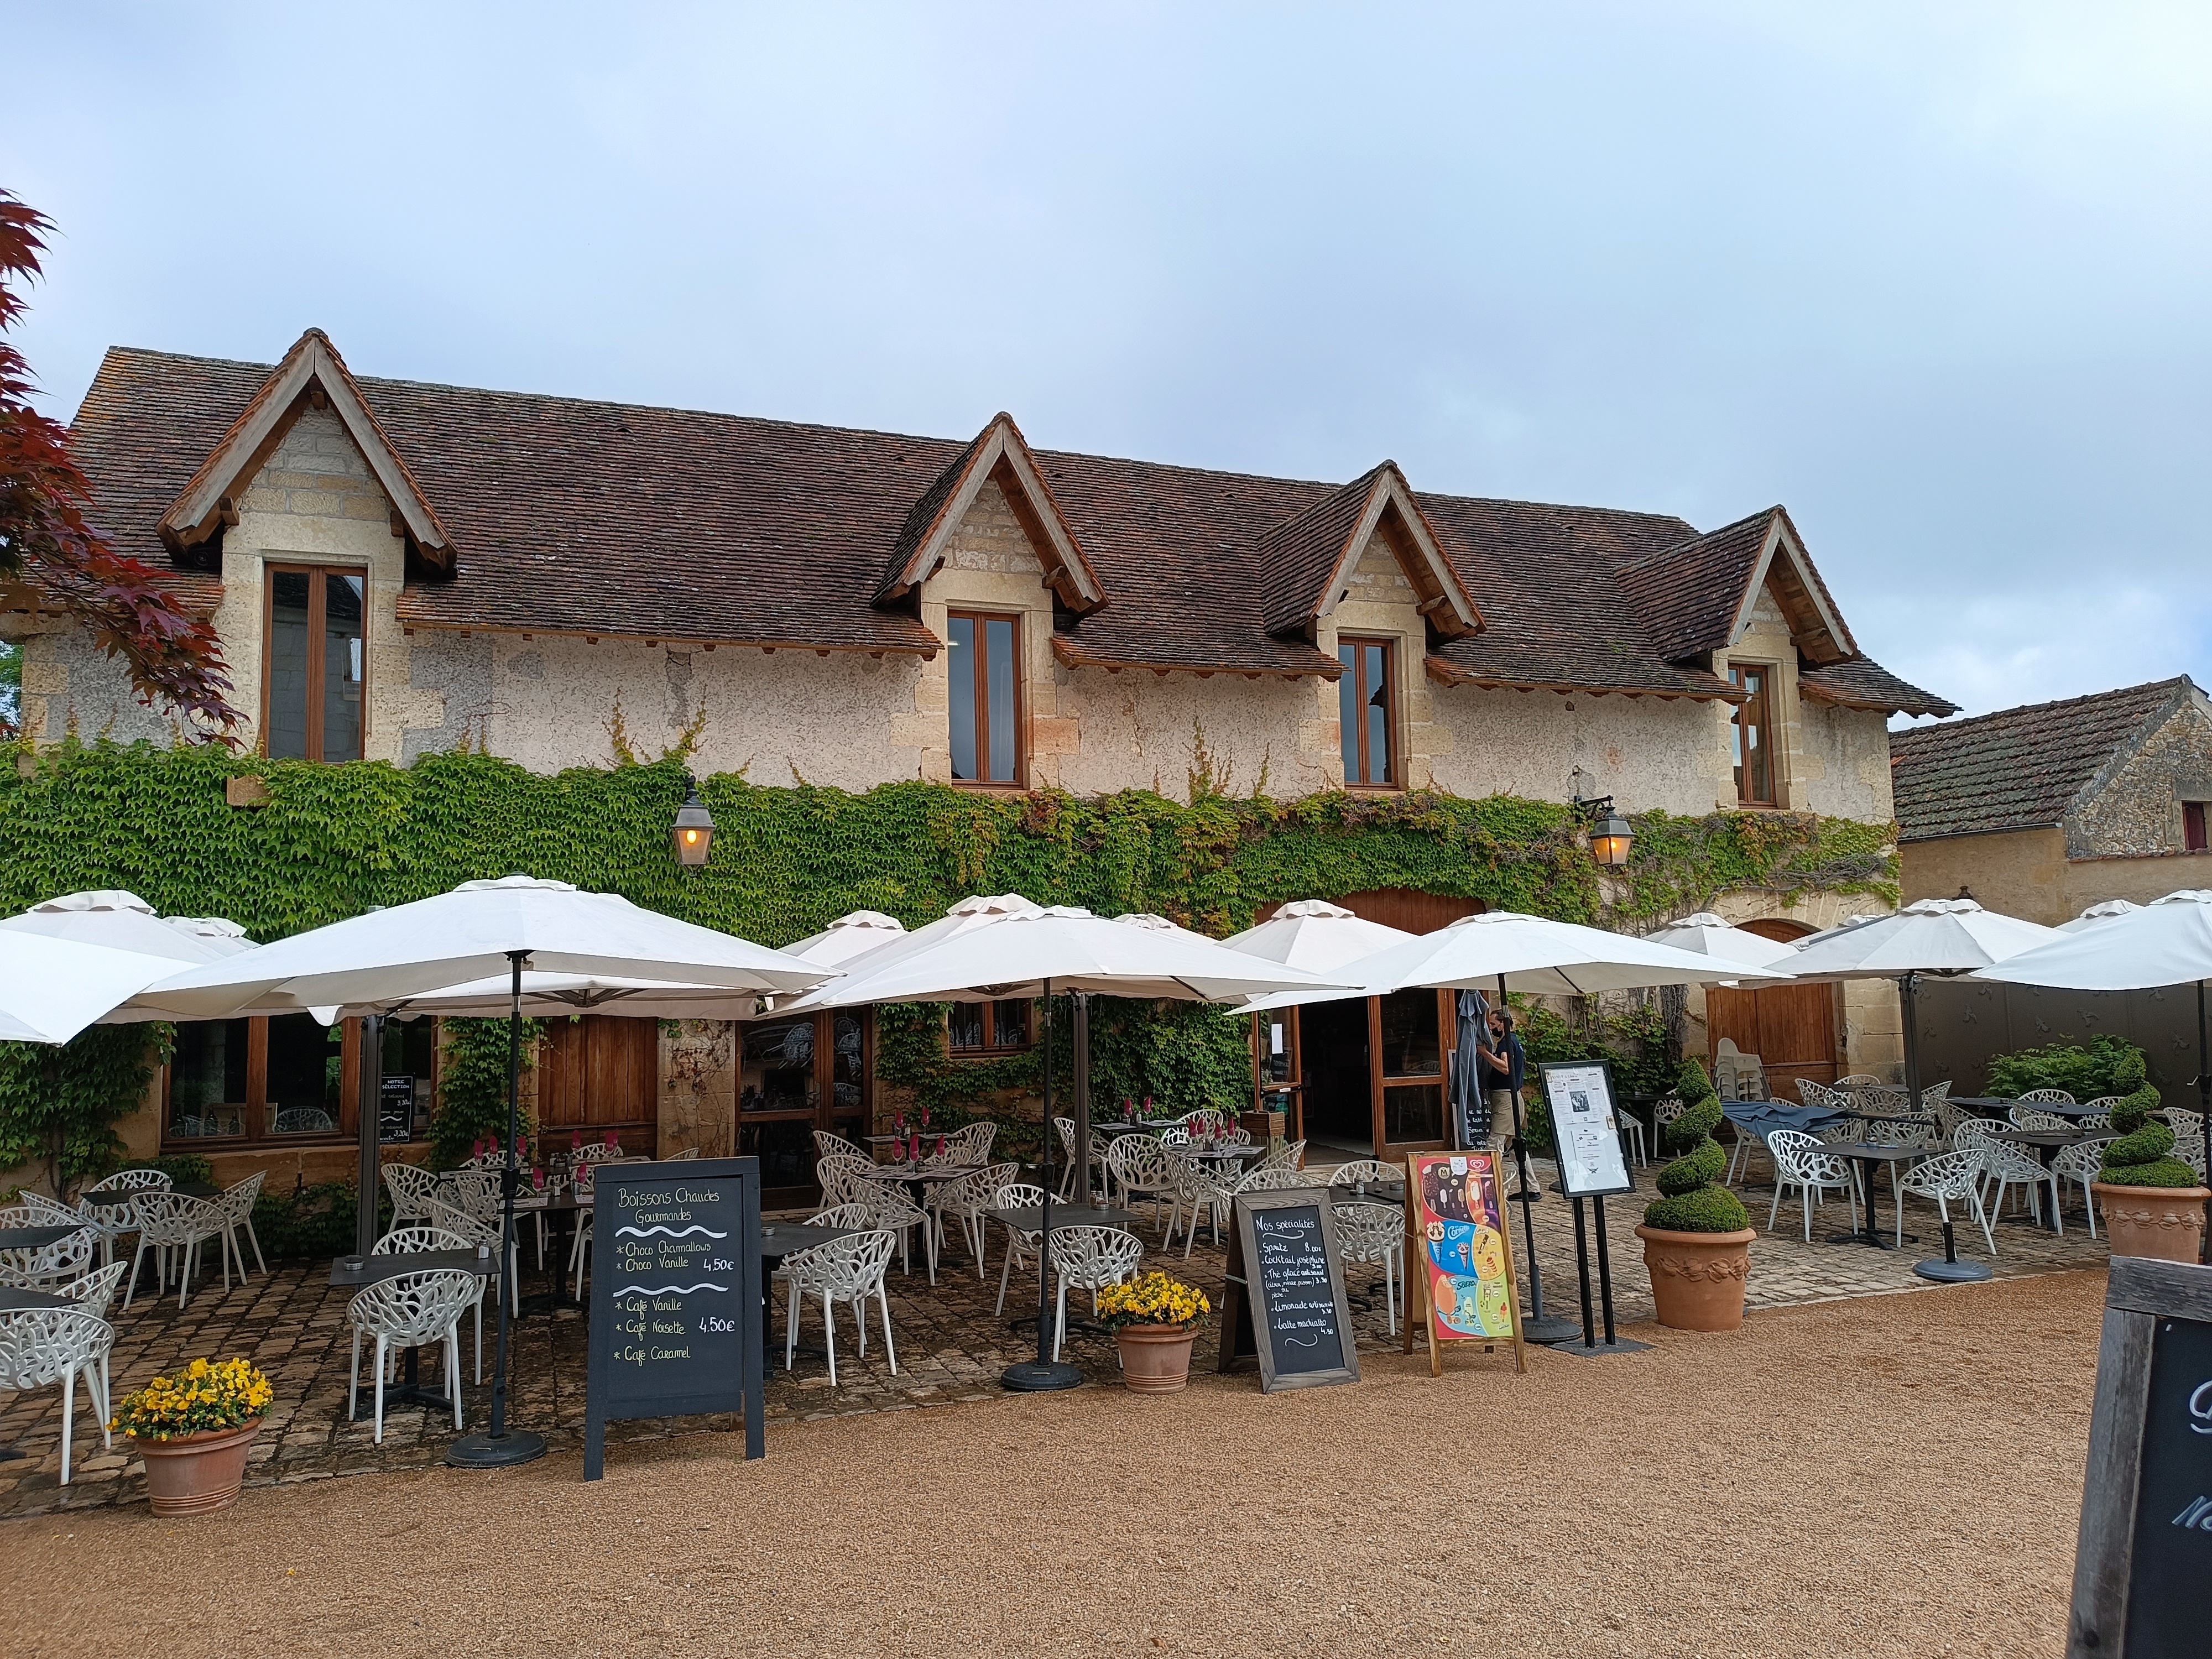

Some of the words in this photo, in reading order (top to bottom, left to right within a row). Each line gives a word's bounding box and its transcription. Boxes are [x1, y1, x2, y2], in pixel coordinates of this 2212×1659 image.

[618, 1188, 671, 1207] Boissons
[675, 1187, 720, 1203] Chaudes
[635, 1207, 692, 1227] Gourmandes
[1256, 1215, 1274, 1231] Nos
[1276, 1218, 1315, 1233] spécialités
[1447, 1225, 1470, 1240] Cornetto
[625, 1241, 654, 1257] Choco
[658, 1240, 711, 1254] Chamallows
[625, 1258, 652, 1272] Choco
[659, 1254, 689, 1269] Vanille
[1265, 1255, 1296, 1264] Cocktail
[1267, 1268, 1281, 1279] Thé
[1282, 1267, 1301, 1281] glacé
[627, 1296, 648, 1321] Café
[652, 1296, 682, 1311] Vanille
[1274, 1300, 1308, 1312] Limonade
[626, 1319, 647, 1342] Café
[653, 1318, 686, 1335] Noisette
[699, 1317, 735, 1334] 4.50€
[1277, 1317, 1297, 1330] Latte
[624, 1345, 646, 1366] Café
[650, 1345, 691, 1360] Caramel
